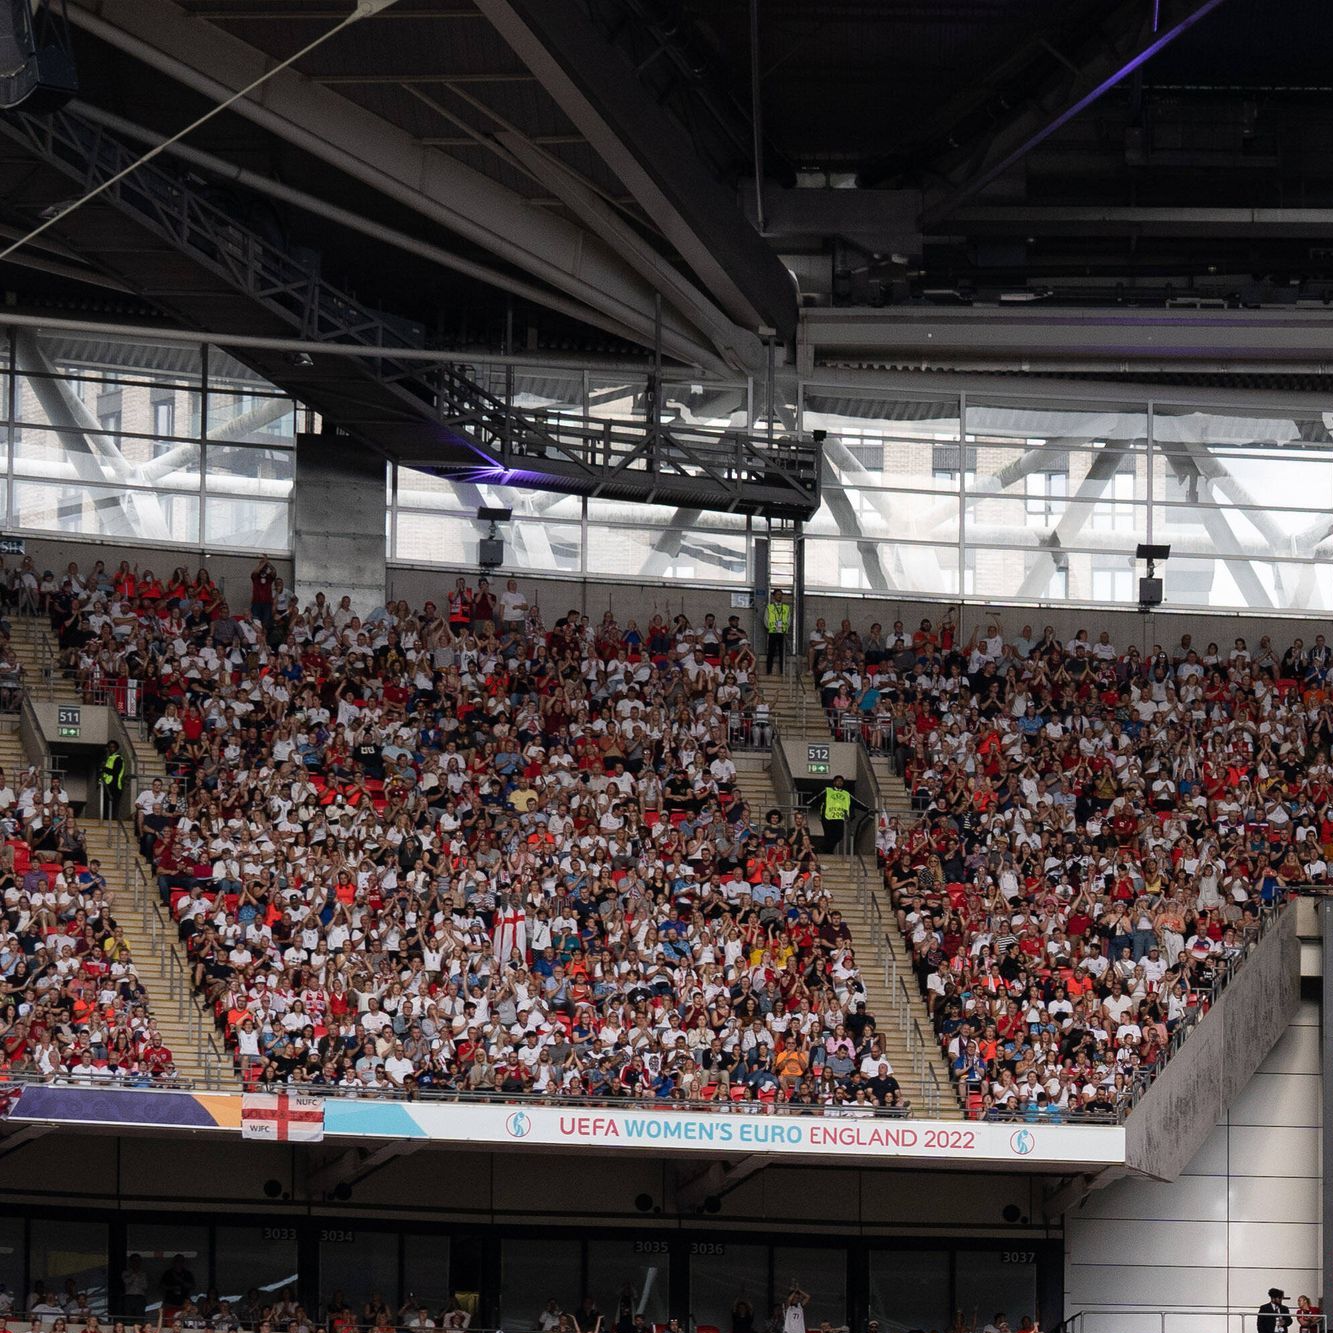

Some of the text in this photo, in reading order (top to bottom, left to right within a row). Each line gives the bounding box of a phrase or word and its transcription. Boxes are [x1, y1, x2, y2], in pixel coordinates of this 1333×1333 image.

[60, 711, 79, 722] 511
[808, 749, 828, 759] 512
[296, 1098, 317, 1106] NUFC
[250, 1124, 270, 1133] WJFC
[559, 1116, 619, 1137] UEFA
[624, 1119, 732, 1141] WOMEN'S
[739, 1122, 802, 1144] EURO
[809, 1126, 917, 1147] ENGLAND
[263, 1227, 297, 1241] 3033
[320, 1229, 354, 1242] 3034
[634, 1241, 670, 1253] 3035
[690, 1242, 725, 1255] 3036
[1002, 1251, 1036, 1264] 3037
